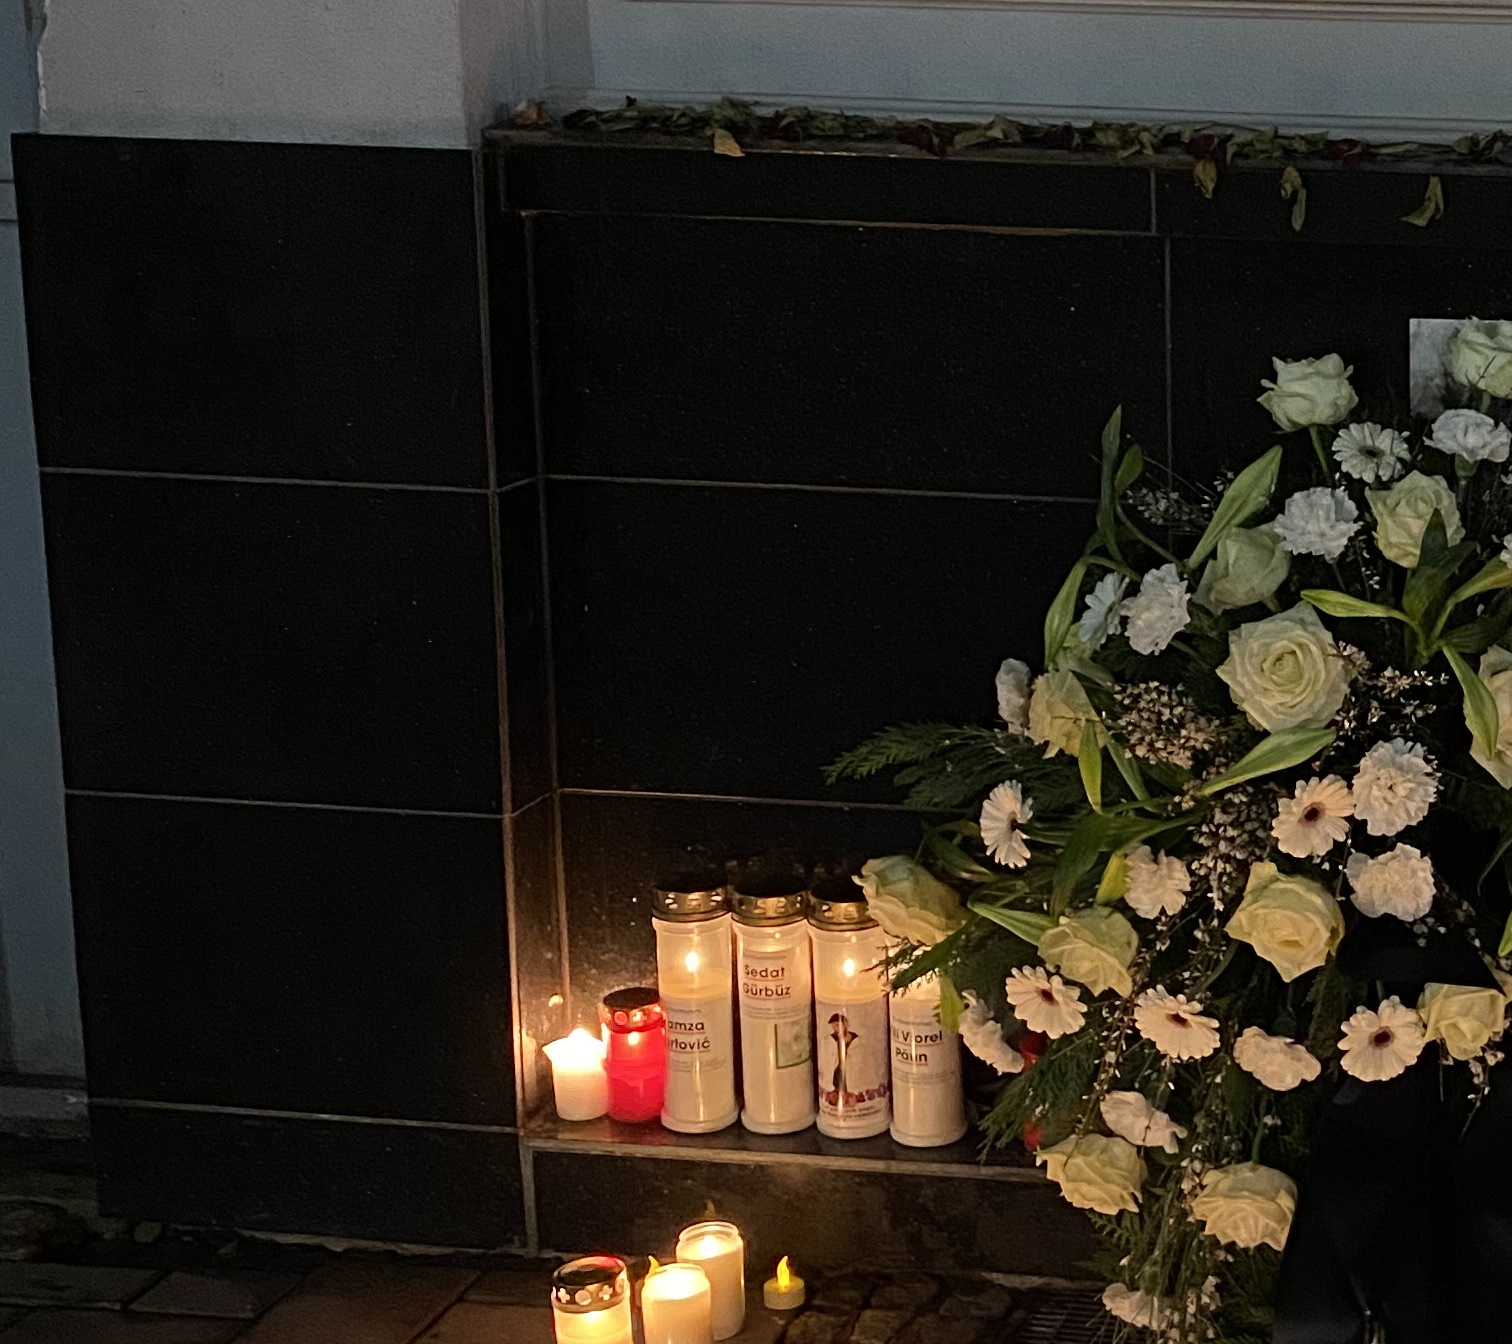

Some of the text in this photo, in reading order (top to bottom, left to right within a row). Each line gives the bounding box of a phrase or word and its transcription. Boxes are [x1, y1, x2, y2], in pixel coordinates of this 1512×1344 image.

[744, 964, 786, 978] Sedat
[668, 1020, 705, 1032] amza
[667, 1036, 712, 1050] rtović
[901, 1030, 944, 1044] Vorel
